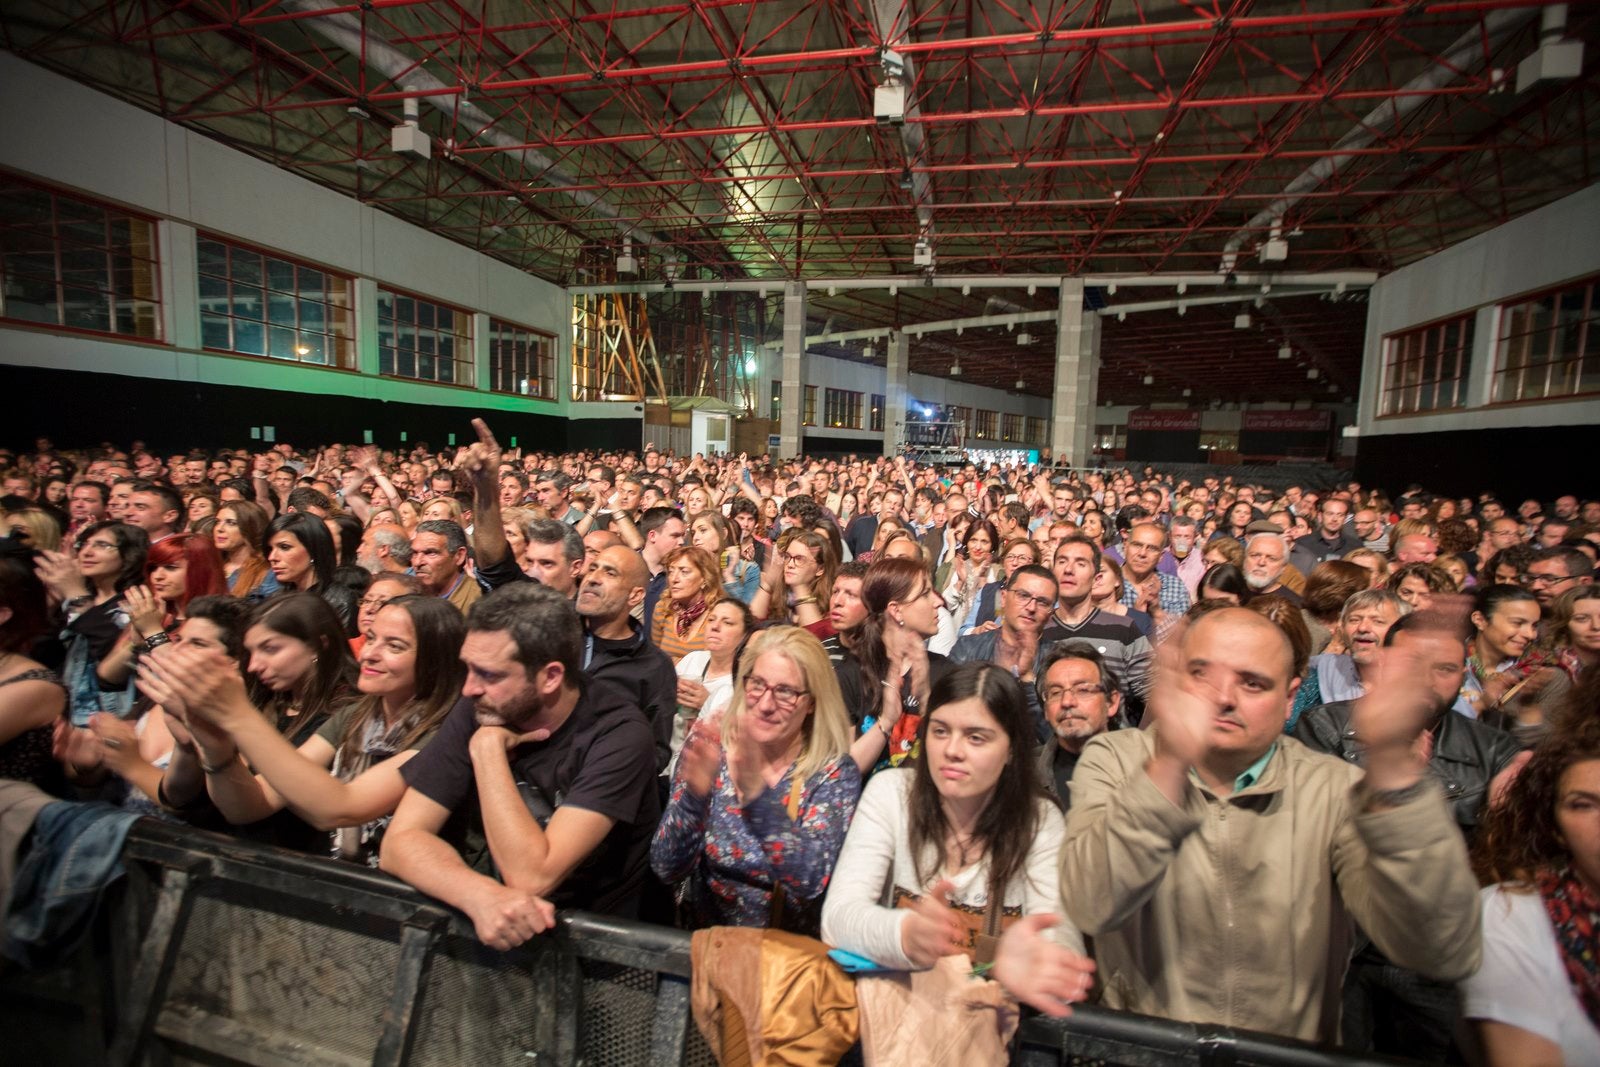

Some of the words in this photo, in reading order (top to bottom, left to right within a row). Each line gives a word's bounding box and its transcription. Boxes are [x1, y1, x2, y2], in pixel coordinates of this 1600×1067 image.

[1131, 419, 1150, 427] Luna
[1151, 419, 1162, 427] de
[1163, 419, 1198, 427] Granada
[1246, 418, 1268, 427] Luna
[1269, 418, 1282, 427] de
[1284, 418, 1325, 427] Granada
